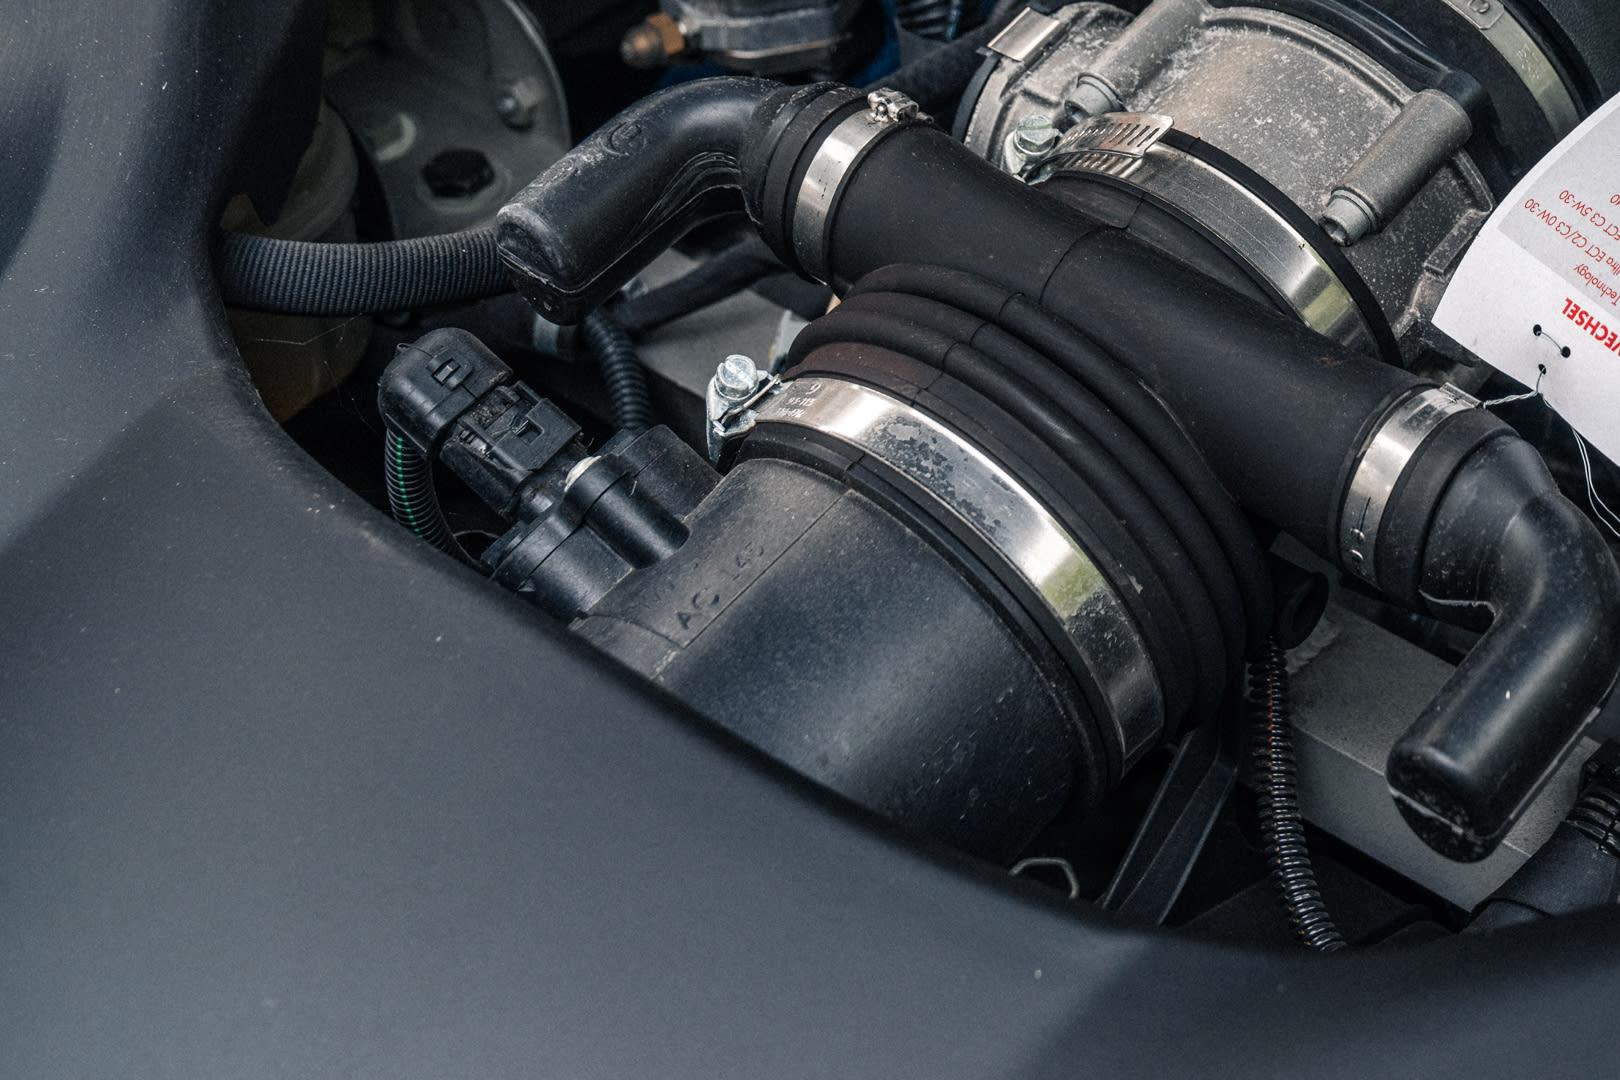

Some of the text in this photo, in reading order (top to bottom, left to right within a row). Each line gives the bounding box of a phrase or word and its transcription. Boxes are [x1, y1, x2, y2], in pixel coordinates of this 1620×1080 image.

[1524, 198, 1557, 227] 0W-30
[1559, 190, 1593, 217] 5W-30
[1589, 211, 1606, 227] C3
[1555, 221, 1588, 248] C2/C3
[1584, 244, 1607, 263] ECT
[1573, 263, 1620, 306] Technology
